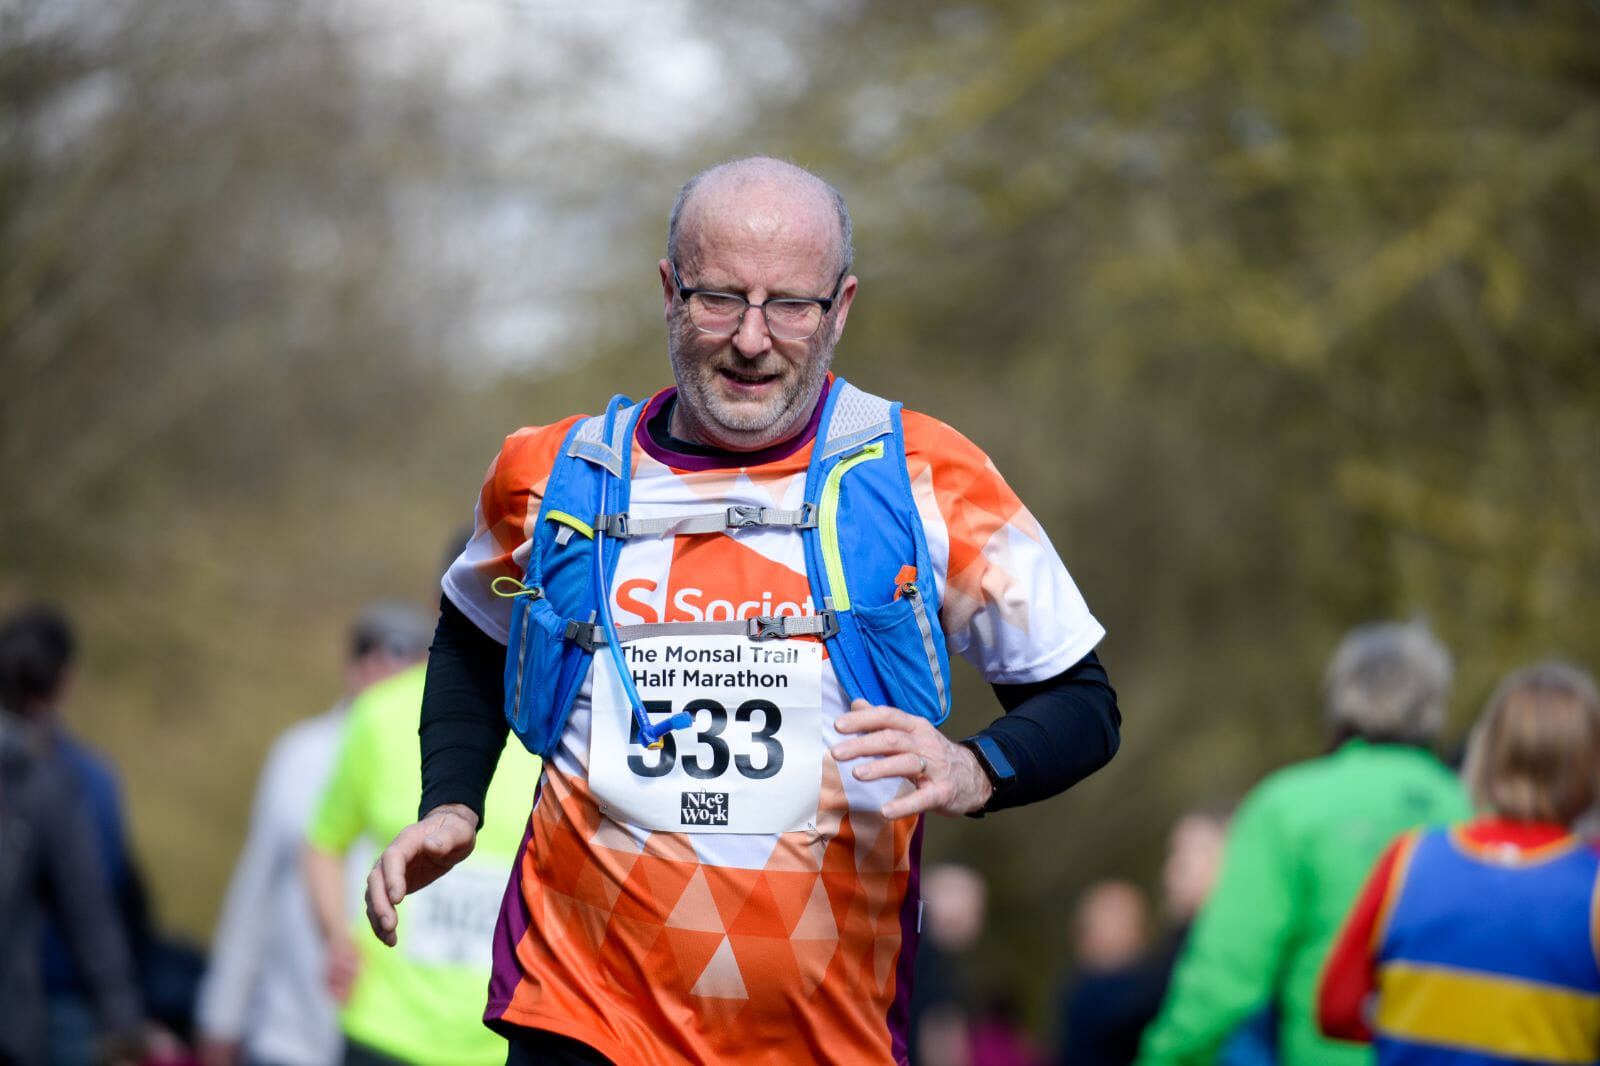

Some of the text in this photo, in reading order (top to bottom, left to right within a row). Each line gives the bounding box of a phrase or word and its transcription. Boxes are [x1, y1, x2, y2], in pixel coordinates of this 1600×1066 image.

[621, 645, 799, 664] The Monsal Trail
[632, 669, 788, 688] Half Marathon
[627, 698, 784, 780] 533
[686, 792, 724, 809] Nice
[681, 804, 728, 825] Work
